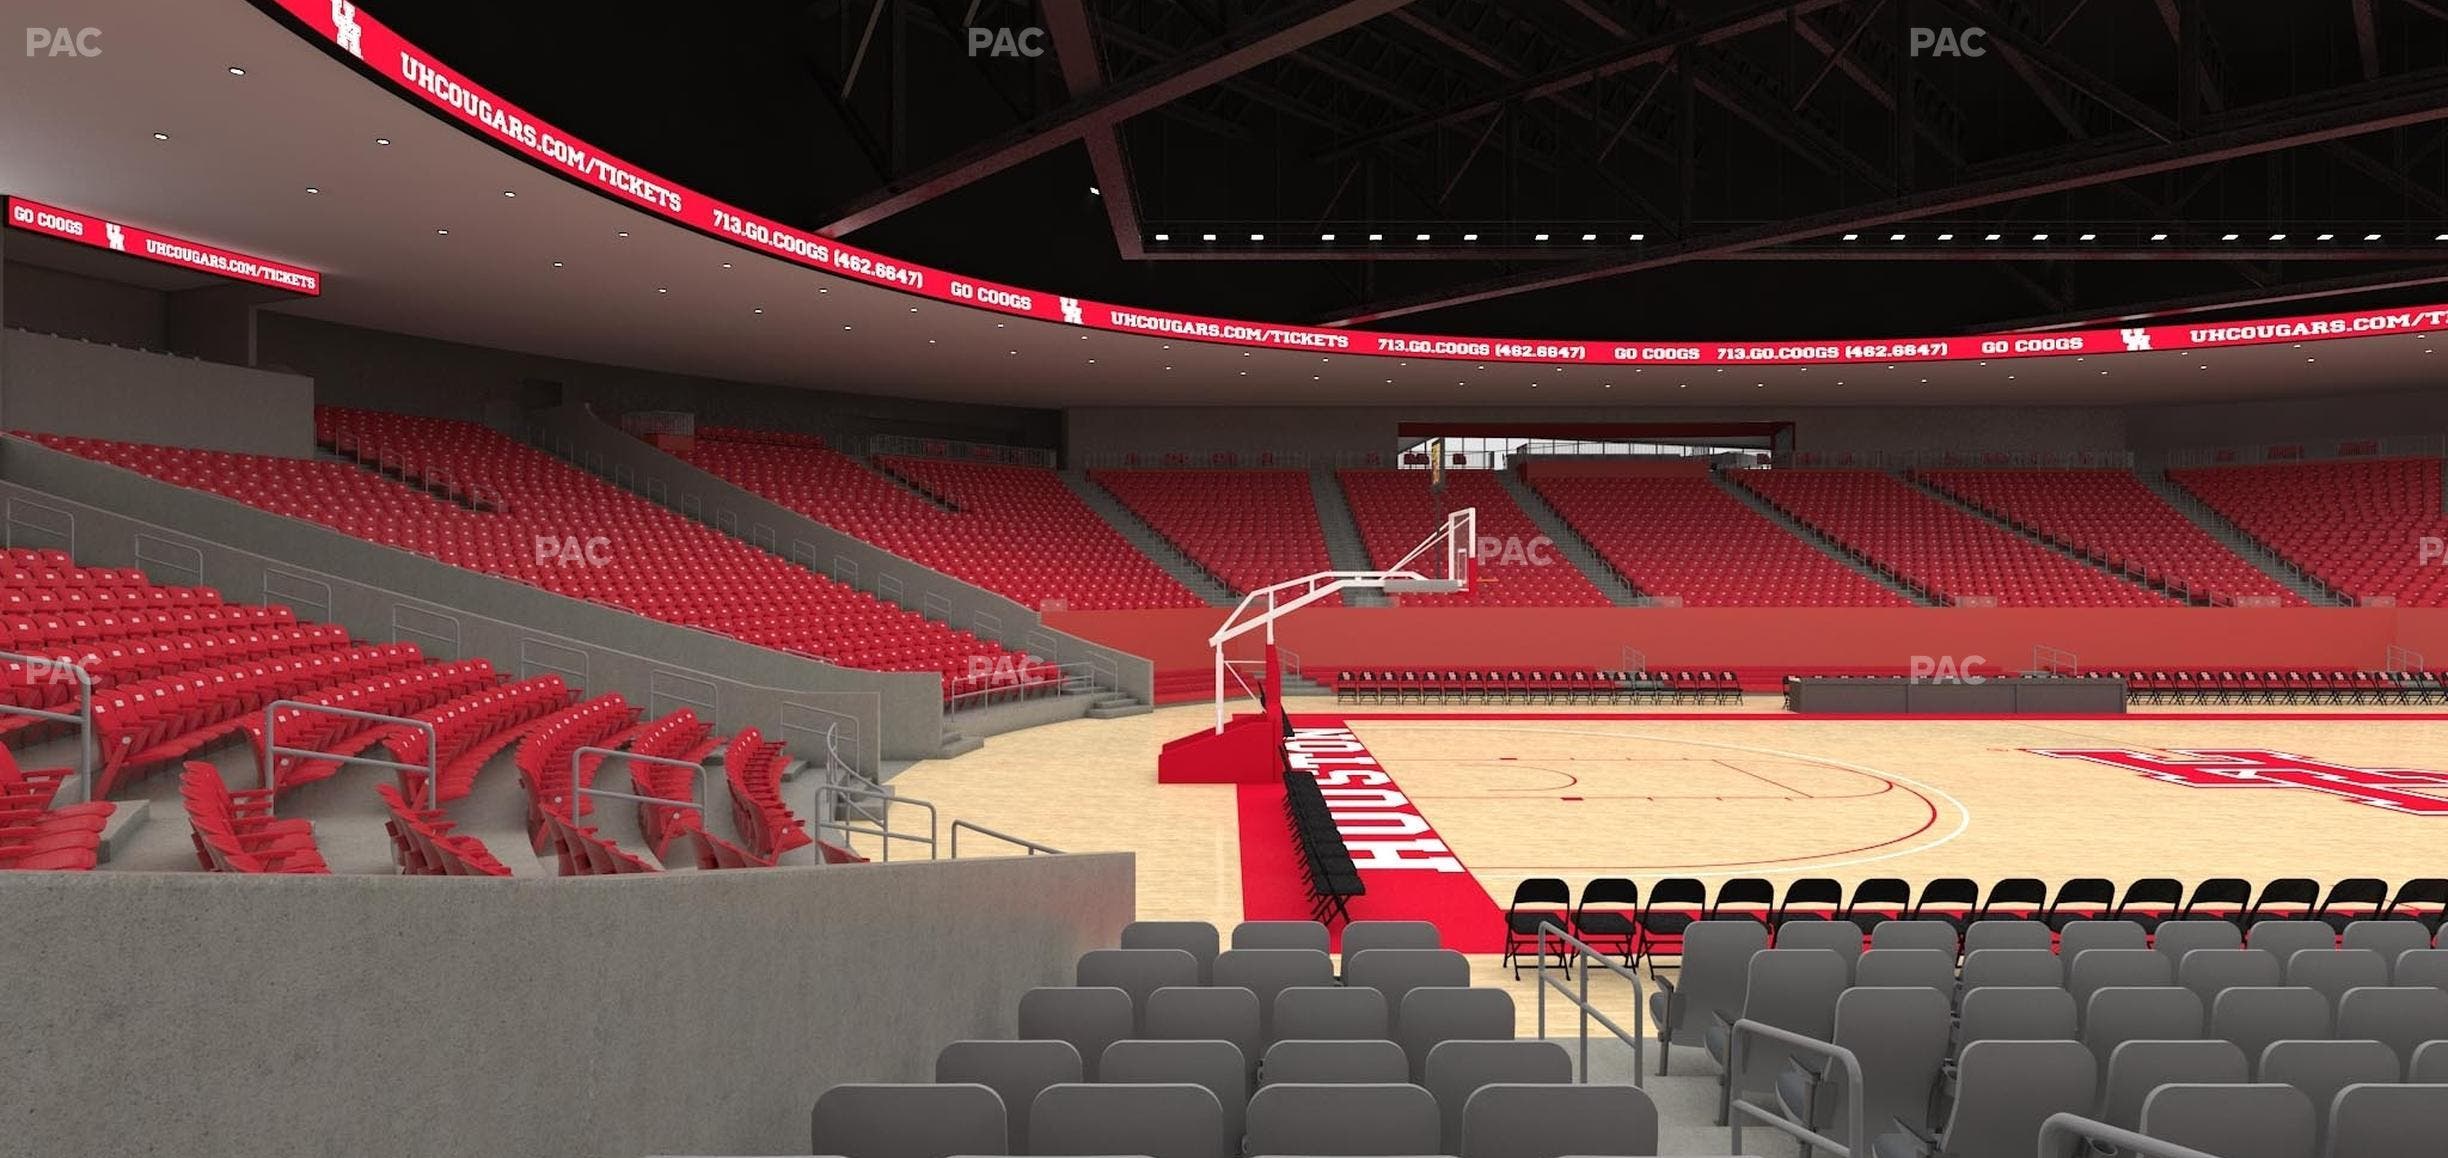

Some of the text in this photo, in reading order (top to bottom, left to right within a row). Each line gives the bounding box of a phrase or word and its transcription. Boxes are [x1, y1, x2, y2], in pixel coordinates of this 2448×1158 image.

[400, 51, 682, 213] UHCOUGARS.COM/TICKETS
[14, 205, 83, 236] GO COOGS
[146, 239, 316, 290] UHCOUGARS.COM/TICKETS
[713, 209, 923, 289] 713.GO.COOGS (462.6647)
[950, 281, 1032, 311] GO COOGS
[1110, 311, 1349, 348] UHCOUGARS.COM/TICKETS
[1377, 338, 1490, 356] 713.GO.COOGS
[1614, 347, 1700, 360] GO COOGS
[1717, 346, 1840, 360] 713.GO.COOGS
[1981, 337, 2084, 354] GO COOGS
[1283, 728, 1467, 873] HOUSTON
